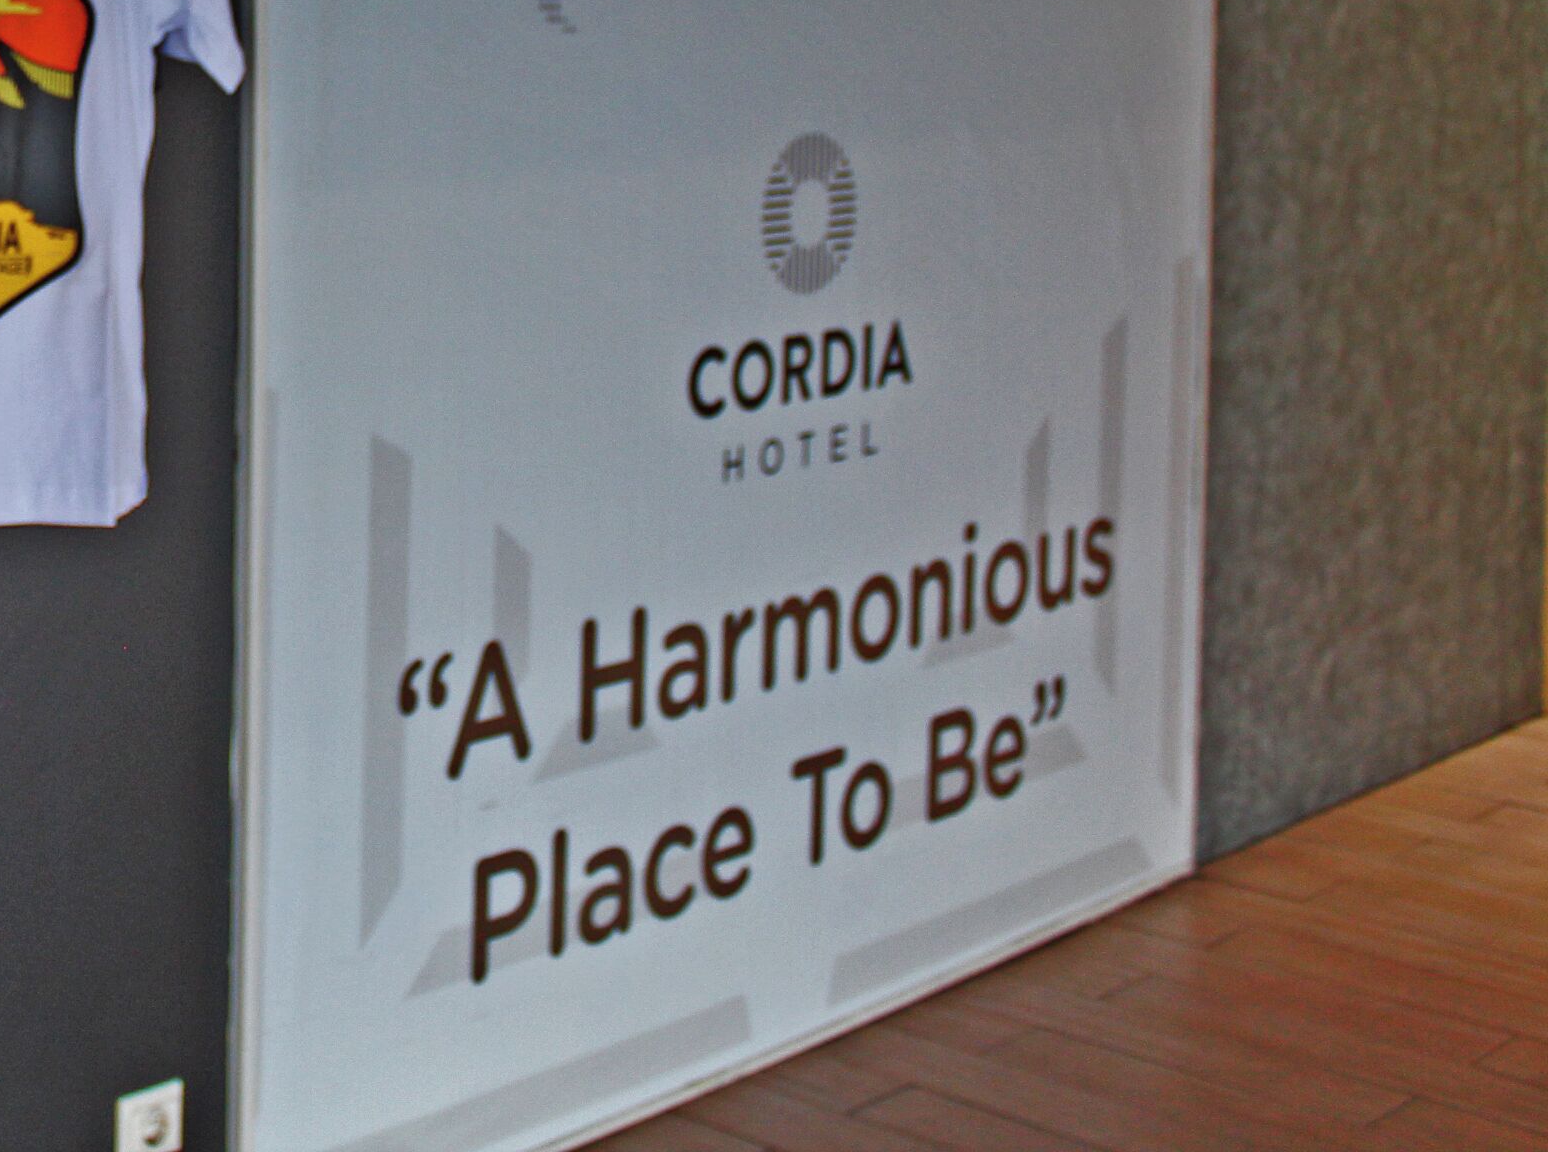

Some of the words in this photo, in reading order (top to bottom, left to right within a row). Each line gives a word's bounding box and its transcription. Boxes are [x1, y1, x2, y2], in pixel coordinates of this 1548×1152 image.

[688, 319, 913, 419] CORDIA
[720, 423, 880, 485] HOTEL
[578, 515, 1117, 744] Harmonious
[470, 804, 756, 985] Place
[791, 744, 893, 866] To
